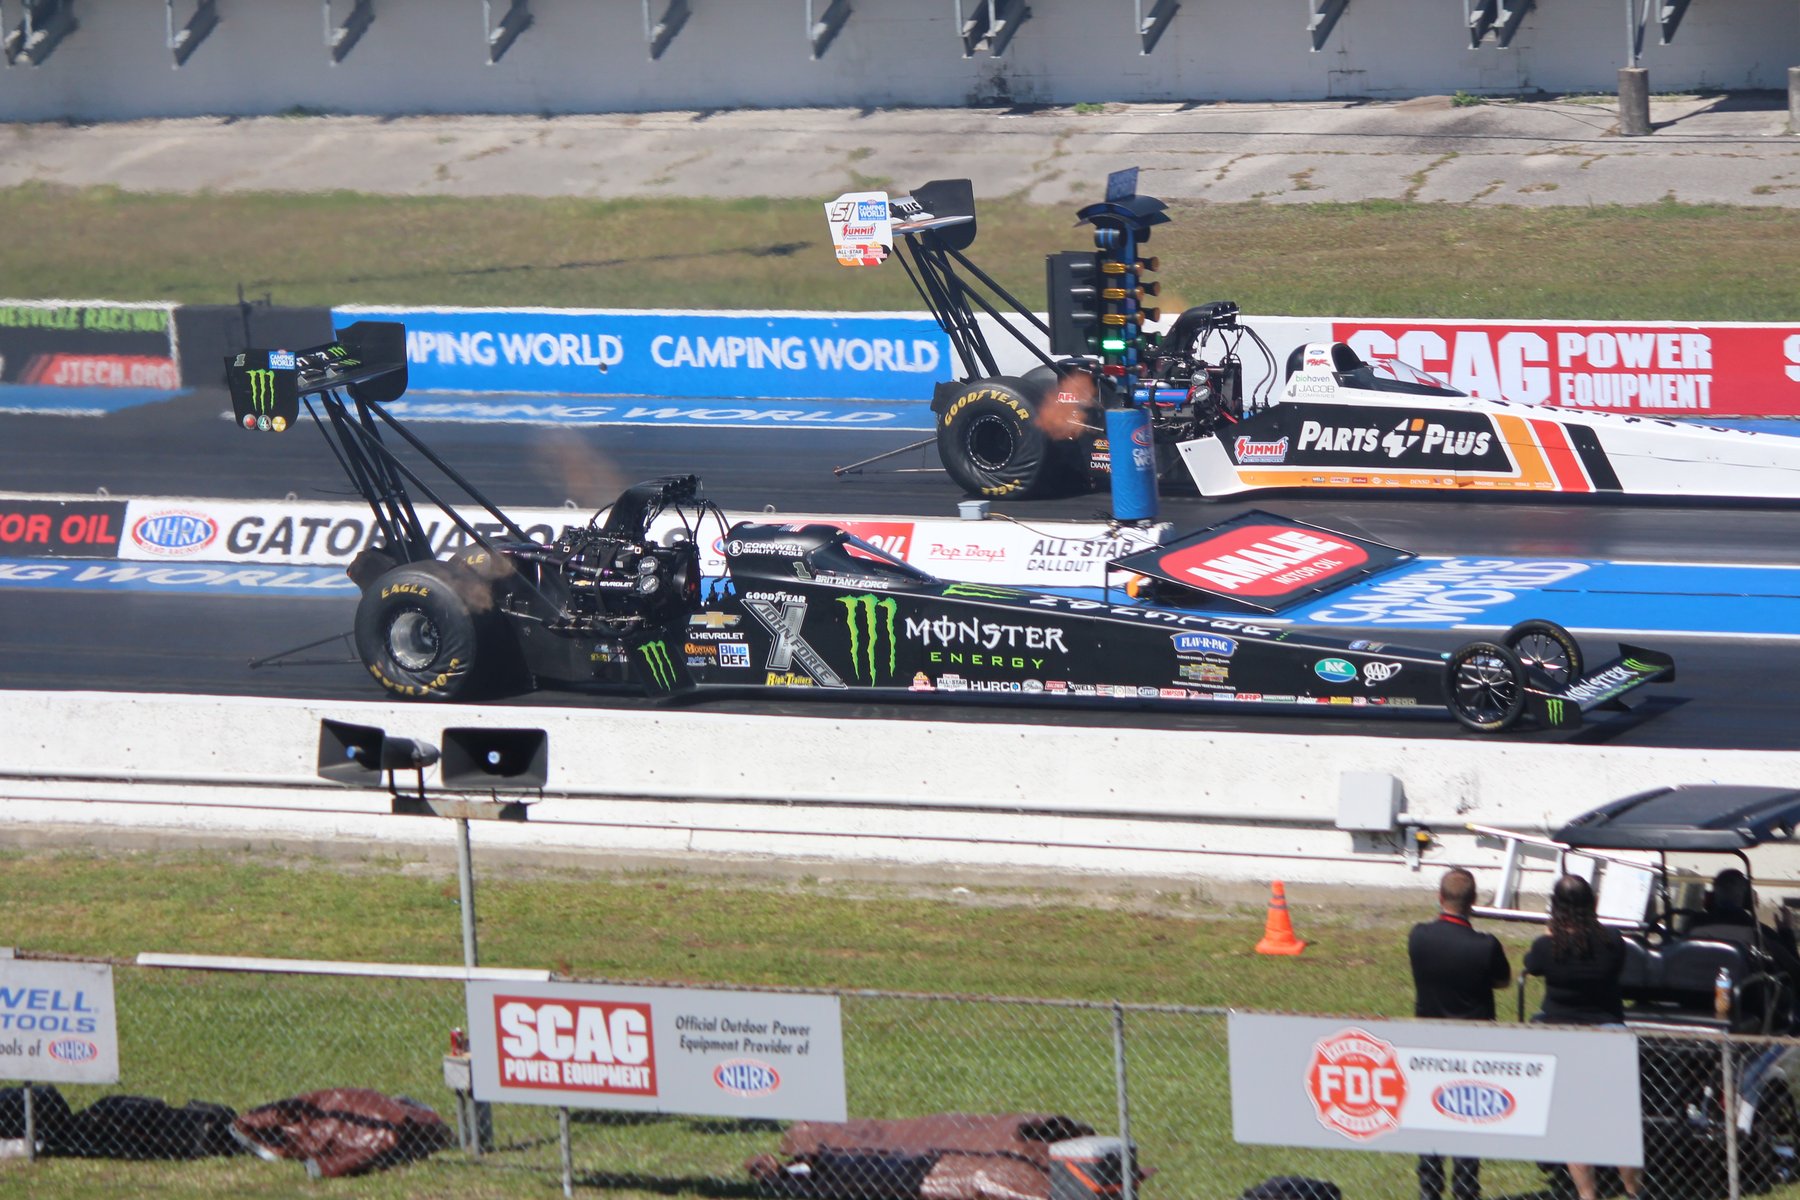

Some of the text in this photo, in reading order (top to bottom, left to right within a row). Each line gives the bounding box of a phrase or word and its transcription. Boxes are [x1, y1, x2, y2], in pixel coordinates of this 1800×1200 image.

[830, 202, 856, 222] 51
[858, 204, 885, 212] CAMPING
[859, 210, 886, 218] WORLD
[270, 354, 295, 362] CAMPING
[498, 332, 624, 366] WORLD
[650, 334, 940, 373] CAMPING WORLD
[1556, 332, 1712, 370] POWER
[271, 359, 294, 367] WORLD
[1346, 329, 1552, 405] SCAG
[1295, 374, 1330, 383] biohaven
[1298, 384, 1335, 394] JACOB
[1558, 373, 1712, 409] EQUIPMENT
[622, 408, 897, 423] WORLD
[944, 389, 1030, 427] GOODYEAR
[1297, 420, 1492, 457] PARTS PLUS
[0, 512, 117, 545] OR OIL
[144, 516, 208, 547] NHRA
[742, 548, 776, 556] QUALITY
[744, 542, 804, 552] CORNWELL
[1030, 539, 1135, 558] ALL STAR
[792, 561, 812, 579] 1
[1026, 558, 1095, 573] CALLOUT
[1185, 530, 1346, 590] AMALIE
[814, 574, 889, 589] BRITTANY FORCE
[1270, 558, 1345, 586] MOTOR OIL
[380, 582, 431, 600] EAGLE
[745, 591, 806, 603] GOODYEAR
[1308, 559, 1518, 623] CAMPING
[1372, 561, 1591, 623] WORLD
[757, 605, 832, 681] JOHN FORCE
[905, 614, 1069, 654] MONSTER
[720, 645, 747, 655] Blue
[721, 656, 746, 666] DEF
[930, 651, 1044, 670] ENERGY
[1364, 663, 1387, 680] AAA
[970, 680, 1021, 692] HURCO
[1160, 688, 1186, 697] SIMPSON
[1, 1013, 96, 1033] TOOLS
[500, 1001, 649, 1065] SCAG
[675, 1015, 811, 1036] Official Outdoor Power
[28, 1039, 41, 1056] of
[53, 1040, 94, 1061] NHRA
[679, 1034, 810, 1055] Equipment Provider of
[503, 1057, 651, 1090] POWER EQUIPMENT
[1408, 1056, 1545, 1077] OFFICIAL COFFEE OF
[721, 1065, 774, 1090] NHRA
[1317, 1065, 1398, 1106] FDC
[1442, 1085, 1506, 1117] NHRA
